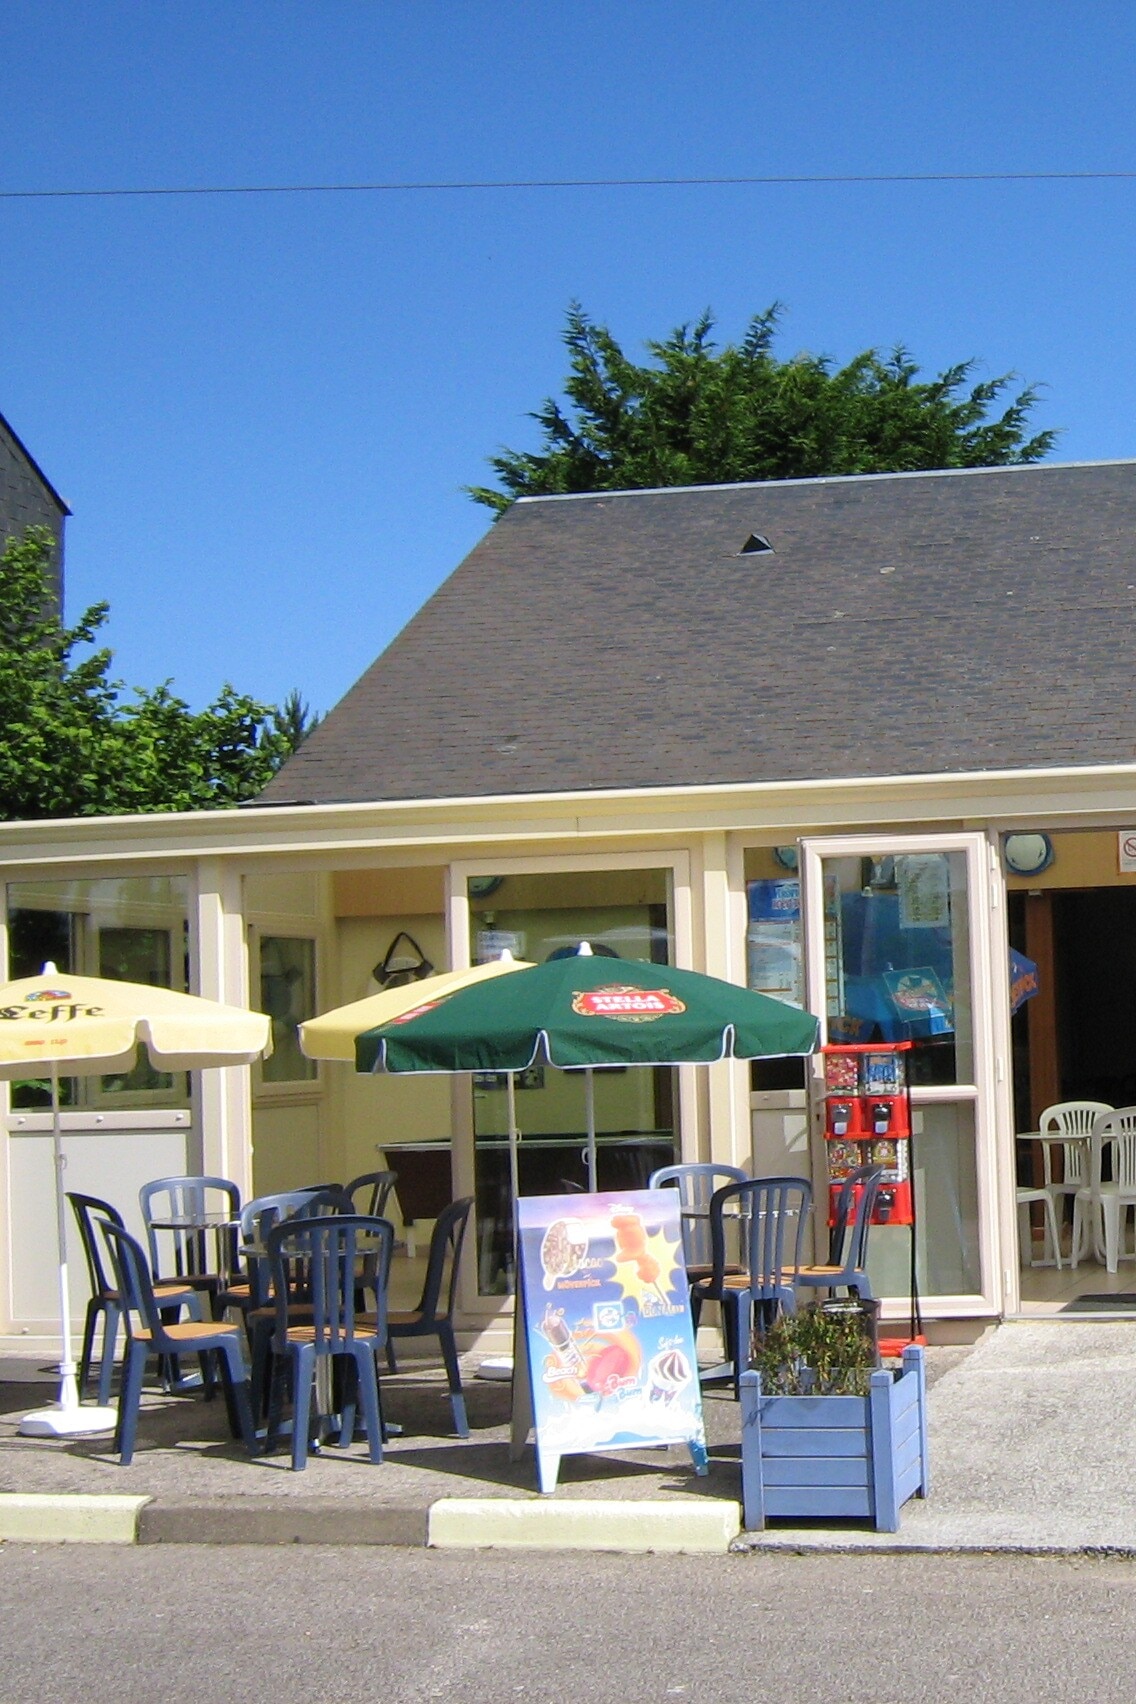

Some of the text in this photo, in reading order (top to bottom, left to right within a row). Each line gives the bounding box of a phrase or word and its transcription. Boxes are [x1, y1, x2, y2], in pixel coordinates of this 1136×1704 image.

[591, 995, 661, 1003] STELLA
[595, 1002, 666, 1011] ARTOIS
[0, 1003, 105, 1024] Leffe
[547, 1366, 578, 1377] Beach
